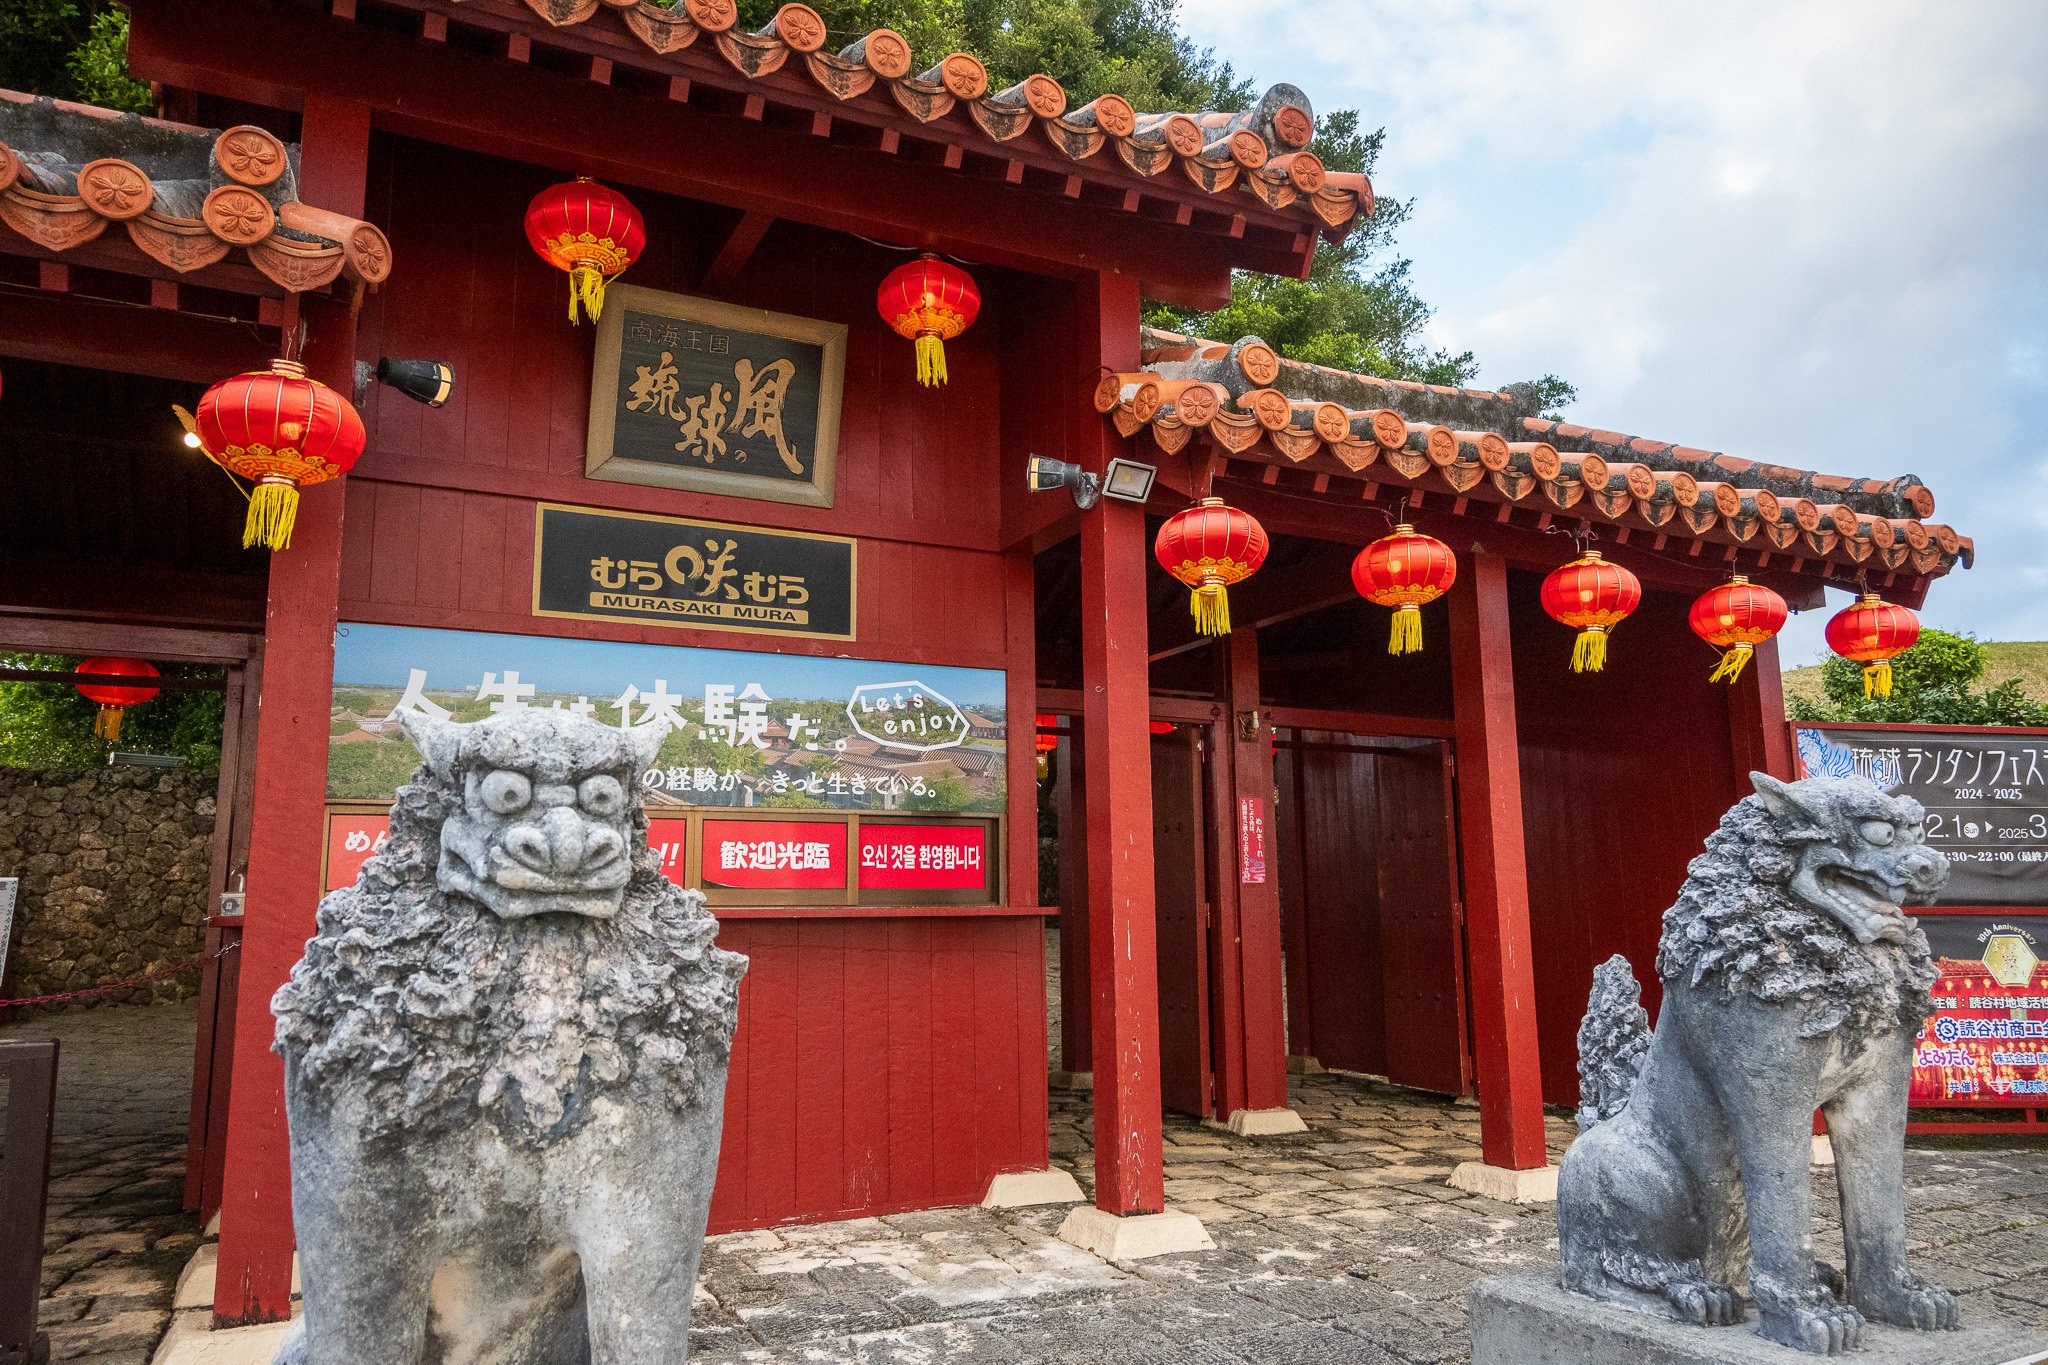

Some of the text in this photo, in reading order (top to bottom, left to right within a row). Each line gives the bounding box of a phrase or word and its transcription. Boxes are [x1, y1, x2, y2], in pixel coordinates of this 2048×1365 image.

[631, 321, 730, 355] 南海王国
[590, 539, 809, 605] むら咲むら
[603, 595, 797, 622] MURASAKI MURA
[861, 687, 924, 712] Let's
[884, 712, 958, 737] enjoy
[1851, 747, 2048, 786] 琉球ランタンフェス
[1954, 788, 1984, 800] 2024
[1993, 788, 2023, 801] 2025
[1255, 817, 1263, 858] めんそーれ
[1998, 828, 2029, 839] 2025
[862, 844, 981, 870] 오신 것을 환영합니다
[1976, 922, 2037, 945] 10th Anniversary
[1919, 1050, 1975, 1066] よみたん
[1993, 1053, 2035, 1064] 株式会社
[2012, 1080, 2048, 1093] 琉球
